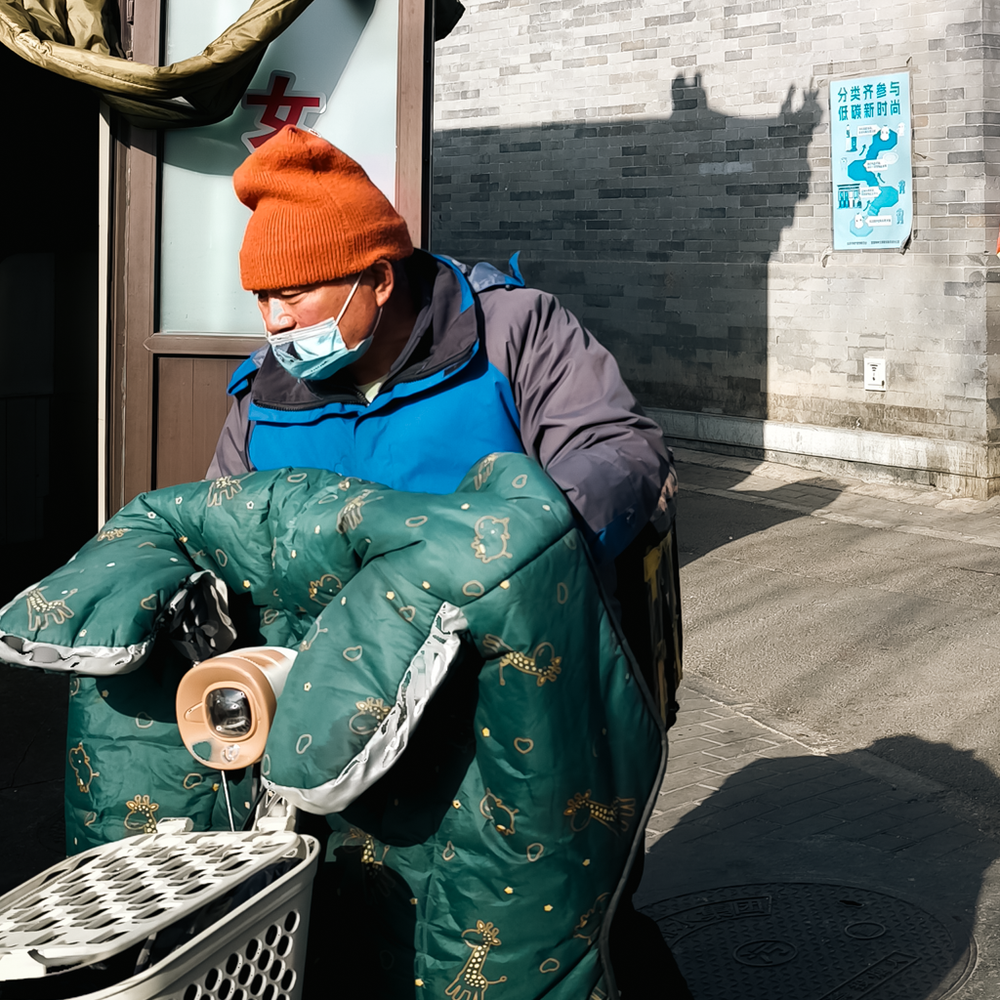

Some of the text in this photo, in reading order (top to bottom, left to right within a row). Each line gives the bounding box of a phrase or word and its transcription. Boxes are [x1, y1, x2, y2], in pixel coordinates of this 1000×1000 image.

[837, 81, 900, 103] 分类齐参与
[247, 75, 320, 149] 女
[838, 99, 901, 121] 低碳新时尚
